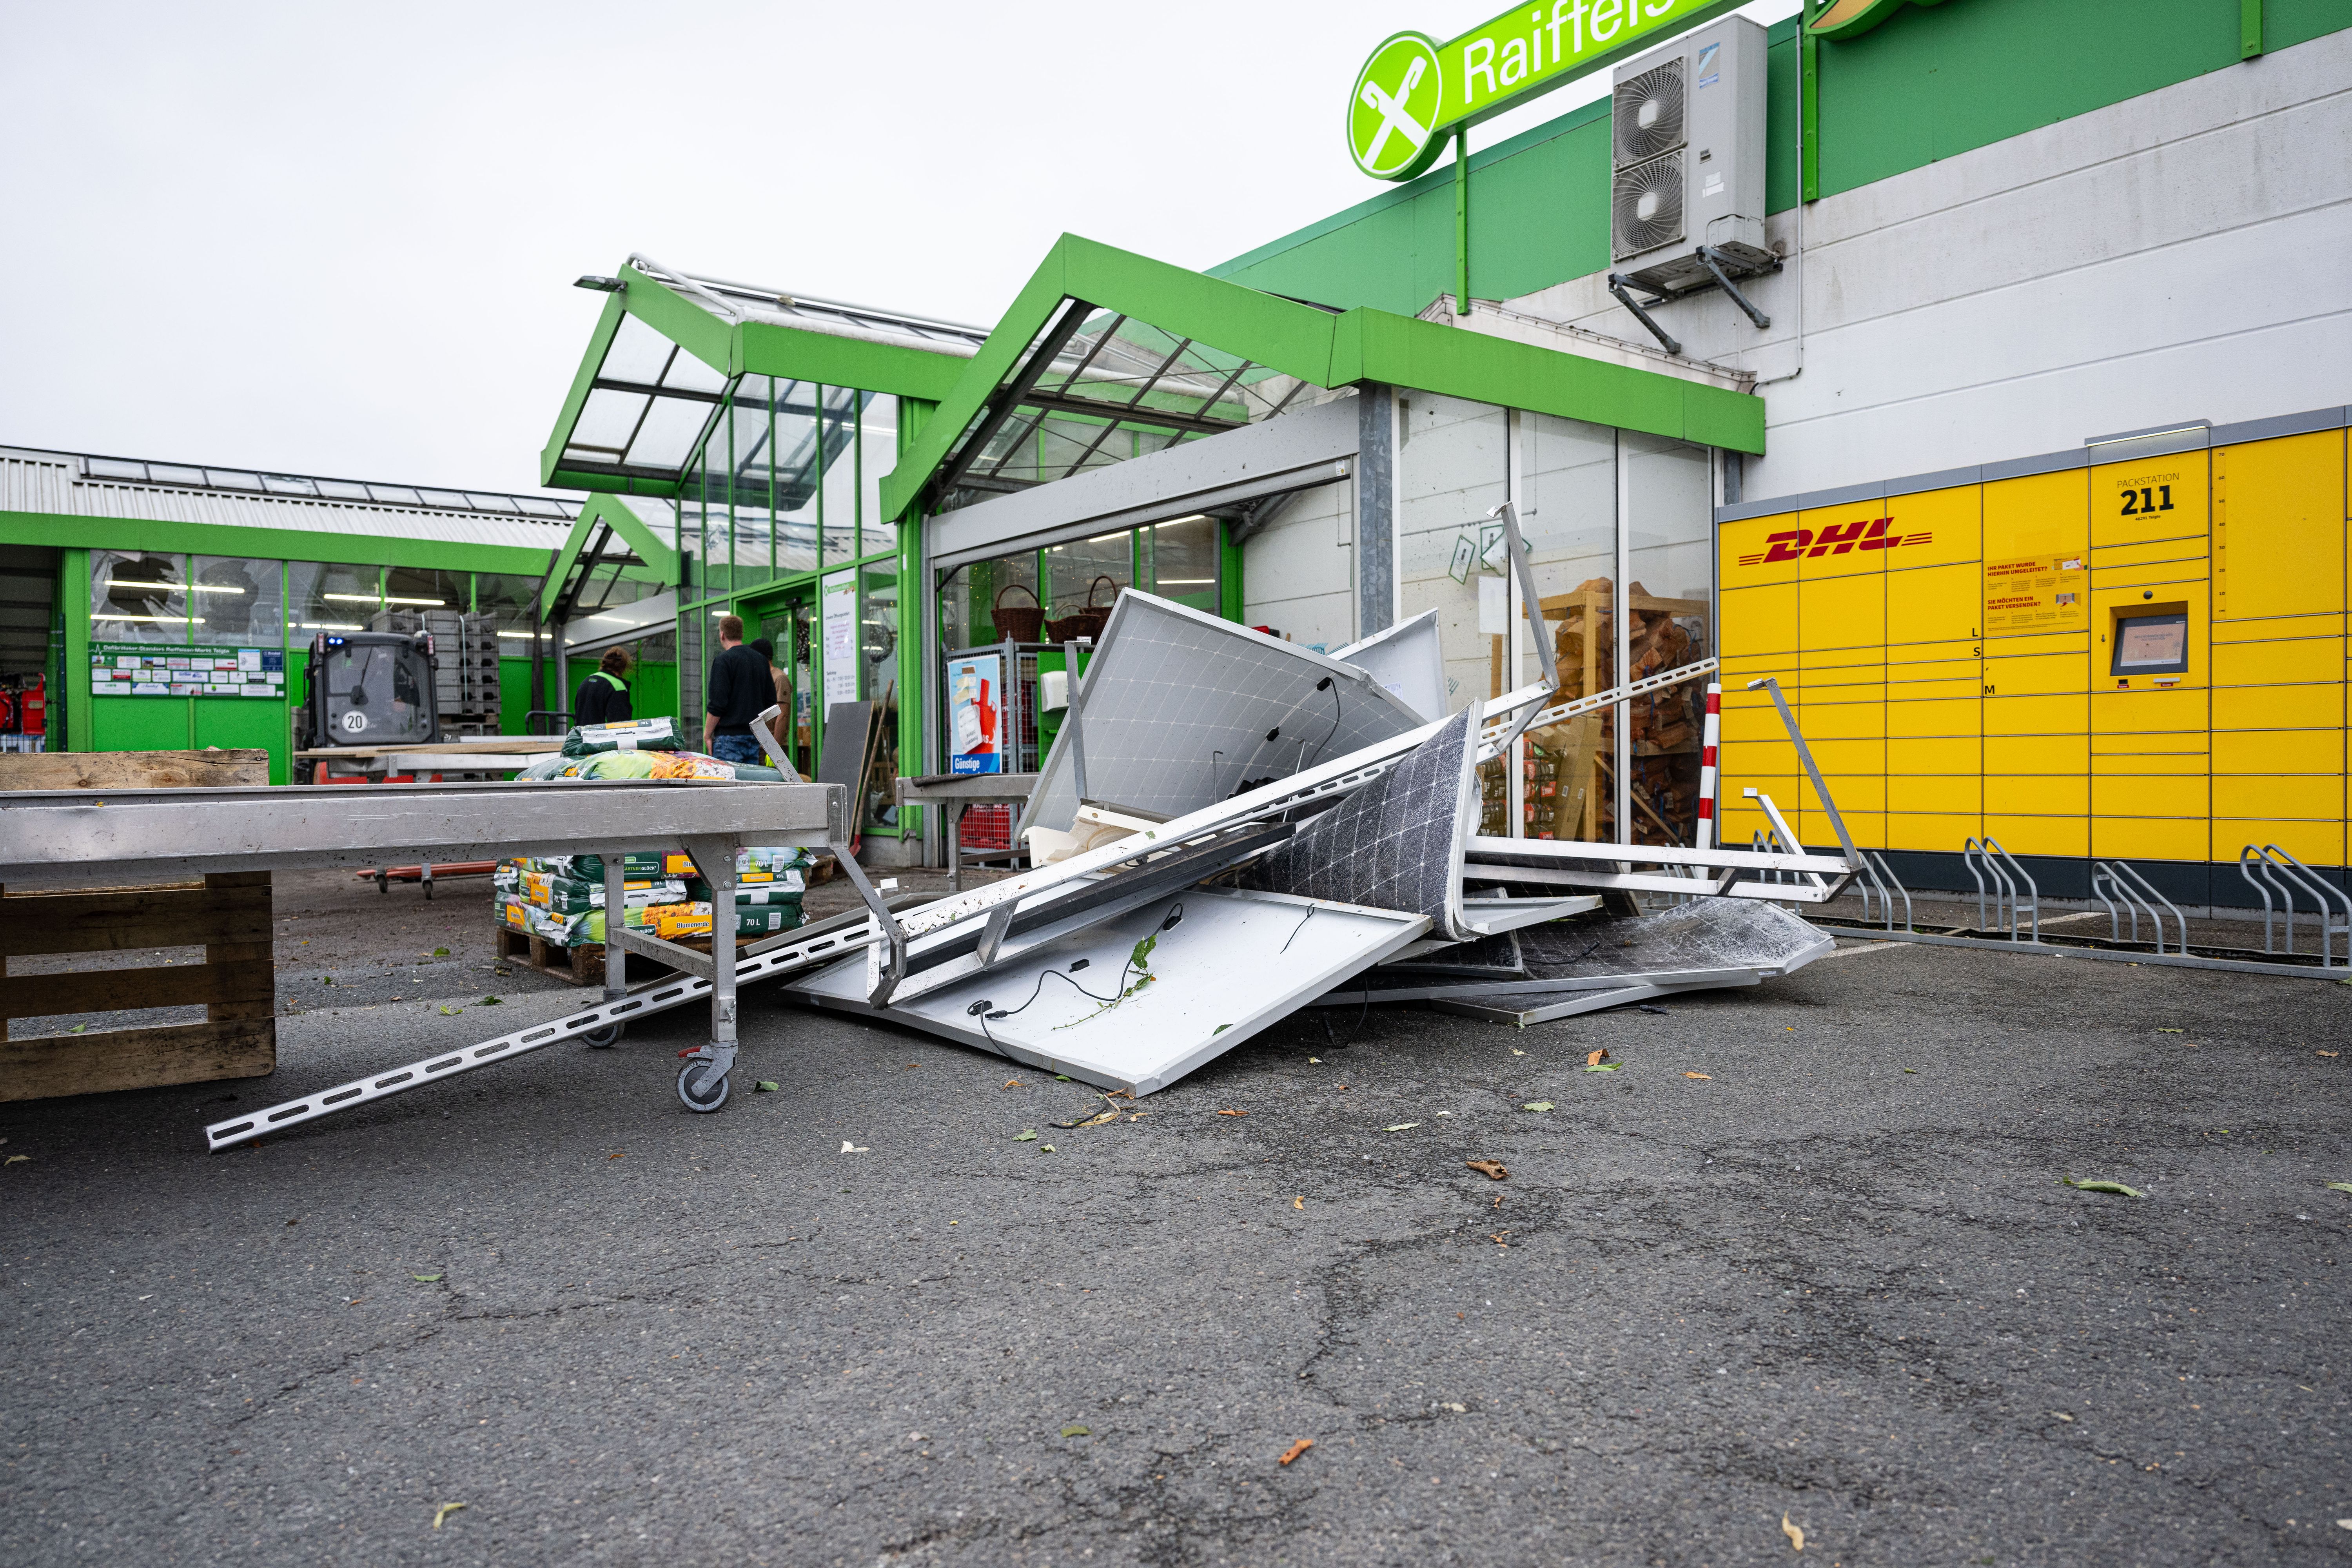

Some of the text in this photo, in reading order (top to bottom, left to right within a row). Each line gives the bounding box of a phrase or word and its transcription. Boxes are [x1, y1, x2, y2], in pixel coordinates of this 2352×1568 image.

[2117, 472, 2180, 488] PACKSTATION
[2120, 485, 2174, 516] 211
[1762, 517, 1904, 563] DHL
[2011, 566, 2047, 575] UMGELEITET?
[1972, 628, 1978, 637] L
[1973, 647, 1980, 657] S
[1985, 685, 1994, 695] M
[348, 716, 362, 728] 20
[955, 757, 980, 771] Günstige
